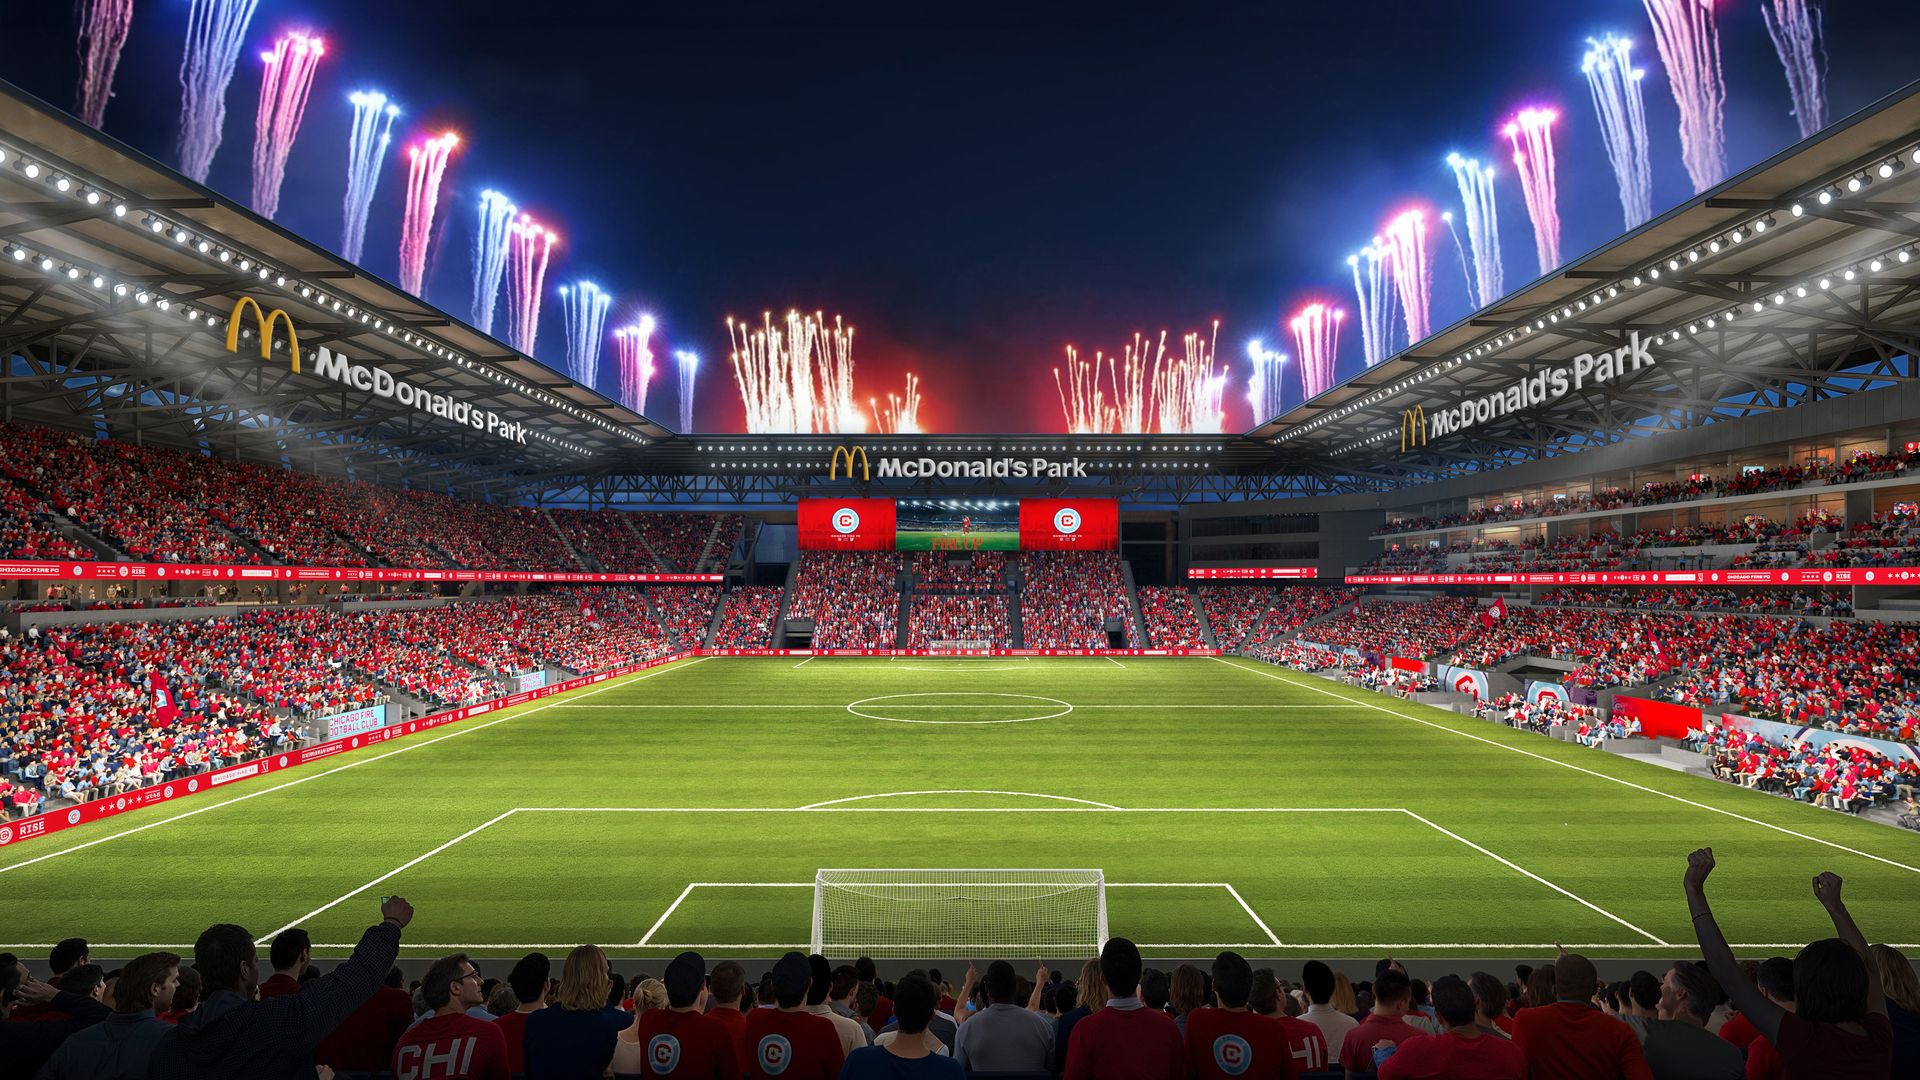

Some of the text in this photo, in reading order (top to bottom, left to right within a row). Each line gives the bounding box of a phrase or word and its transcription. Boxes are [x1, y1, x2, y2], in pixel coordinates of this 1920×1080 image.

[314, 346, 484, 430] McDonald's
[486, 411, 527, 445] Park
[1431, 367, 1570, 440] McDonald's
[1574, 331, 1656, 391] Park
[877, 458, 1027, 478] McDonald's
[1032, 458, 1087, 478] Park
[361, 709, 374, 719] FIRE
[330, 717, 378, 736] OOTBALL CLUB
[19, 821, 45, 835] RISE
[397, 1036, 477, 1080] CHI
